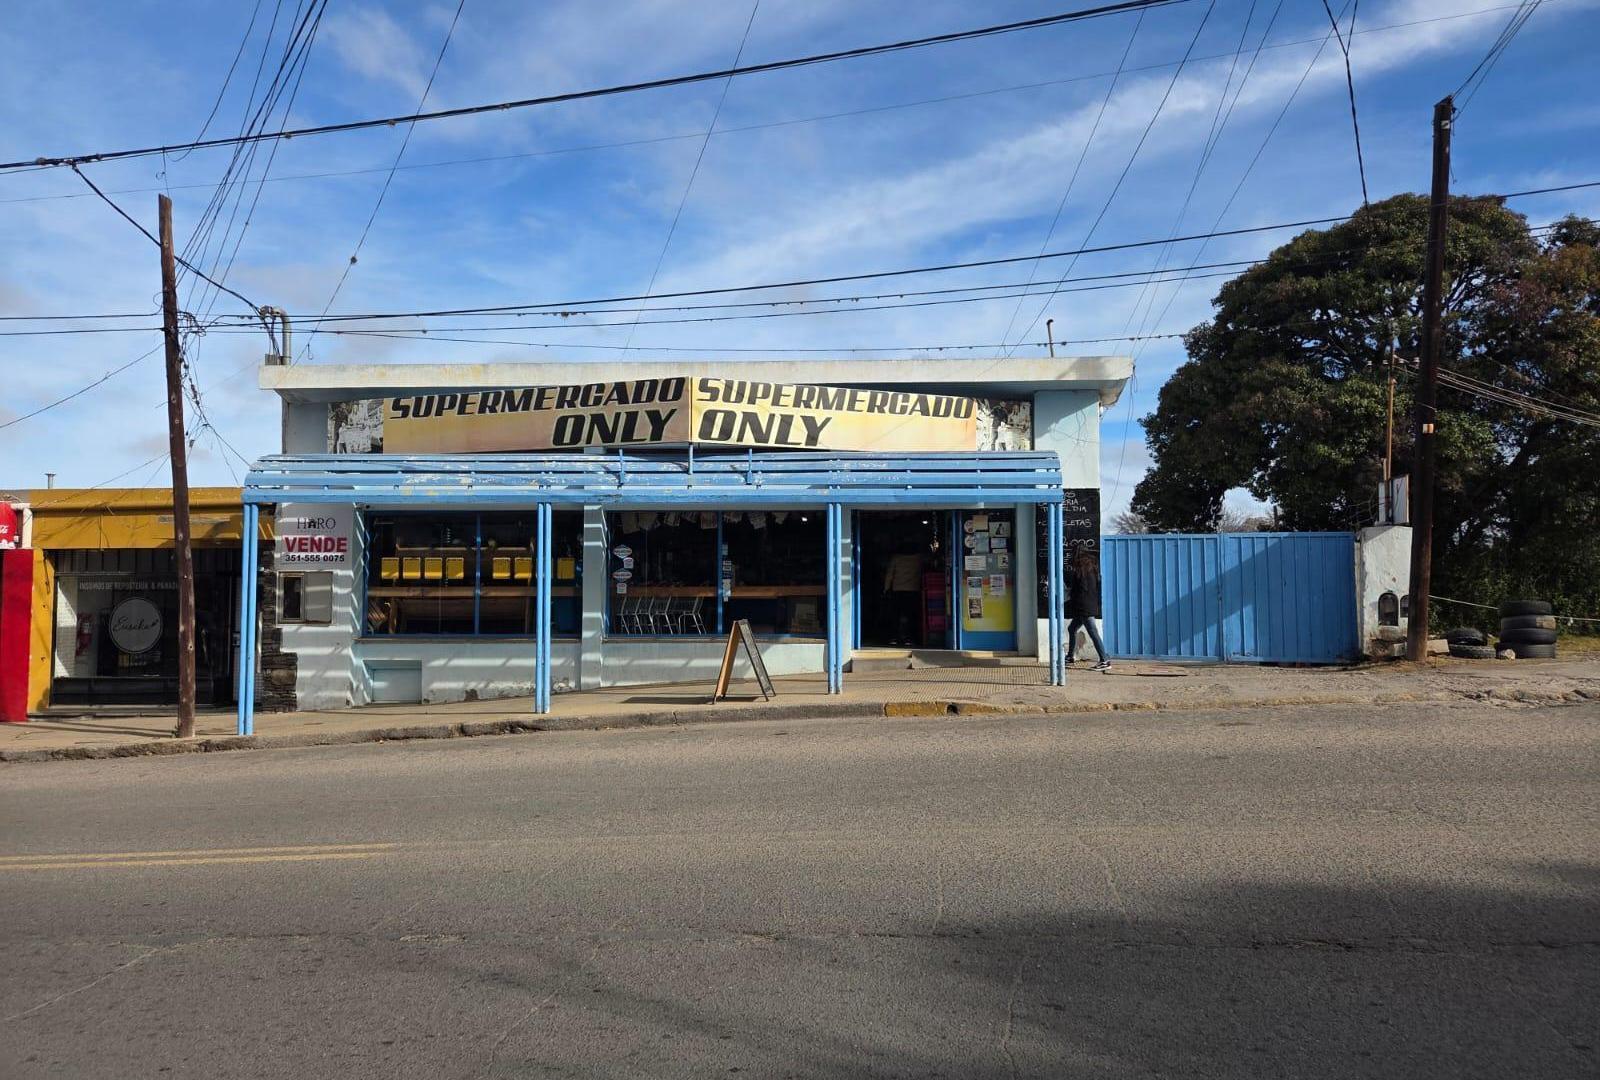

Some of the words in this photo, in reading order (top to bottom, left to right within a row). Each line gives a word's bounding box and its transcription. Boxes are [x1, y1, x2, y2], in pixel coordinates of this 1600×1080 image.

[389, 376, 685, 419] SUPERMERCADO
[696, 377, 974, 419] SUPERMERCADO
[552, 408, 677, 446] ONLY
[697, 408, 832, 446] ONLY
[297, 517, 336, 529] HARO
[284, 536, 347, 553] VENDE
[285, 554, 320, 562] 351-555
[323, 554, 345, 562] 0075
